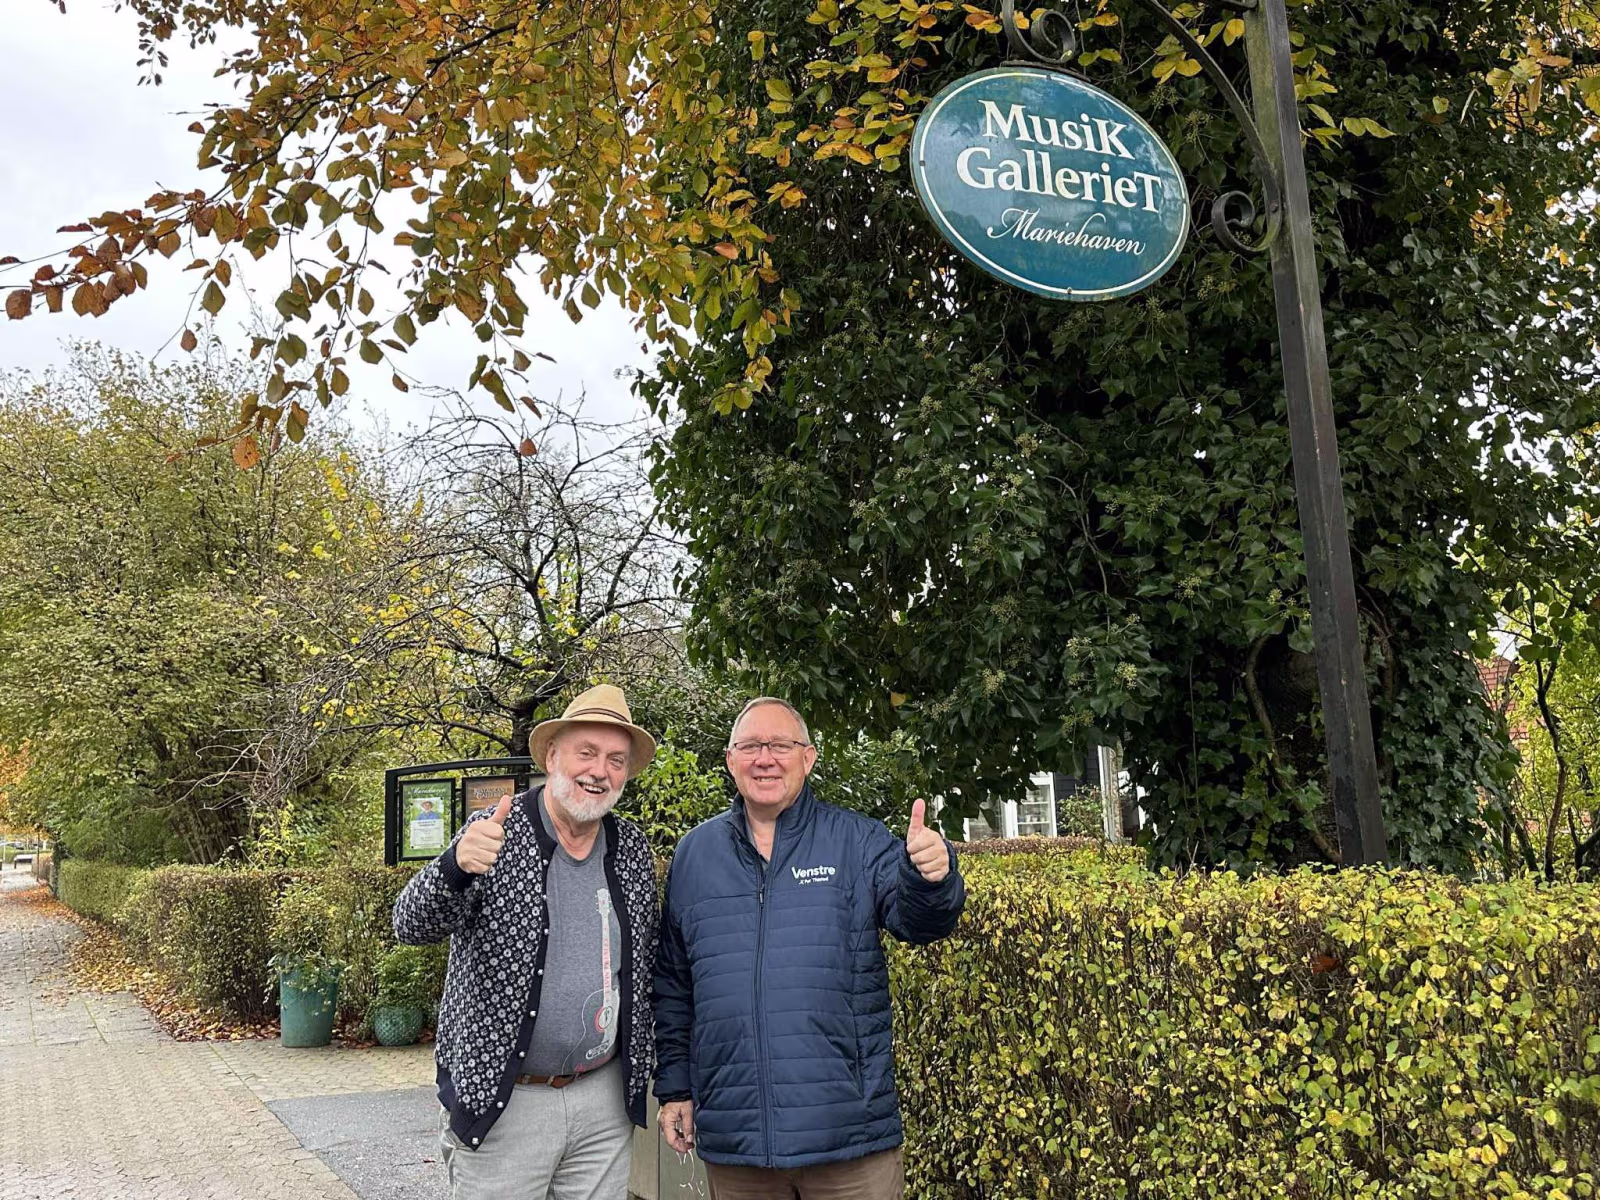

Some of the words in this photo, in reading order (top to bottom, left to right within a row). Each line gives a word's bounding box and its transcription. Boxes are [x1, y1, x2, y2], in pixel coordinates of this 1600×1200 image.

[978, 99, 1135, 160] MusiK
[956, 146, 1162, 213] GallerieT
[986, 207, 1146, 256] Mariehaven
[791, 865, 836, 879] Venstre
